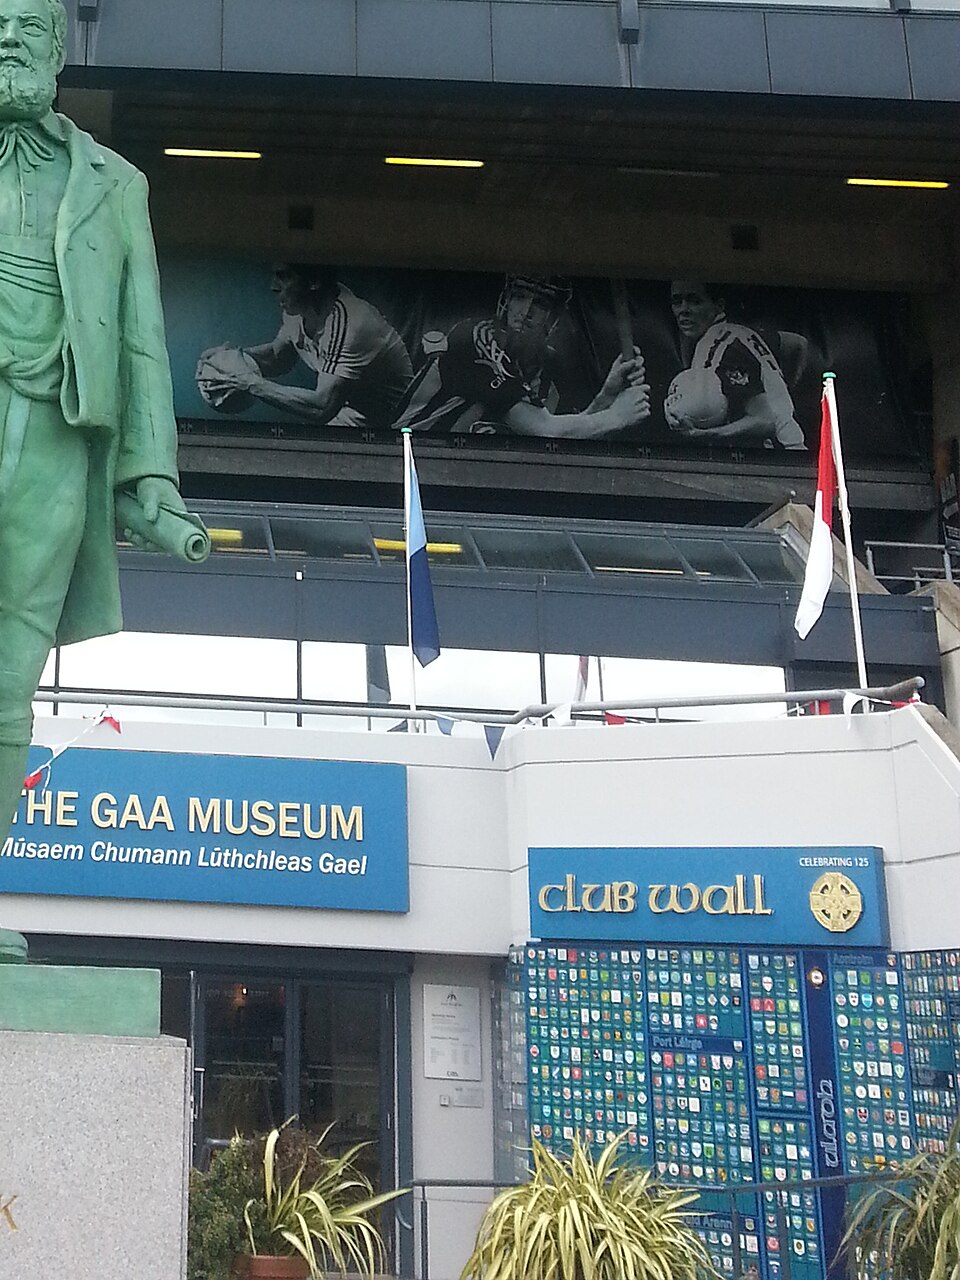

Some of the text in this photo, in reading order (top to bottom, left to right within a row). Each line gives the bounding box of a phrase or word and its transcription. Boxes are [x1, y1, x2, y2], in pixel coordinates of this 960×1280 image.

[12, 789, 364, 841] HE GAA MUSEUM
[91, 841, 192, 866] Chumann
[319, 852, 368, 875] Gael
[799, 857, 869, 868] CELEBRATING 125
[648, 874, 775, 916] wall
